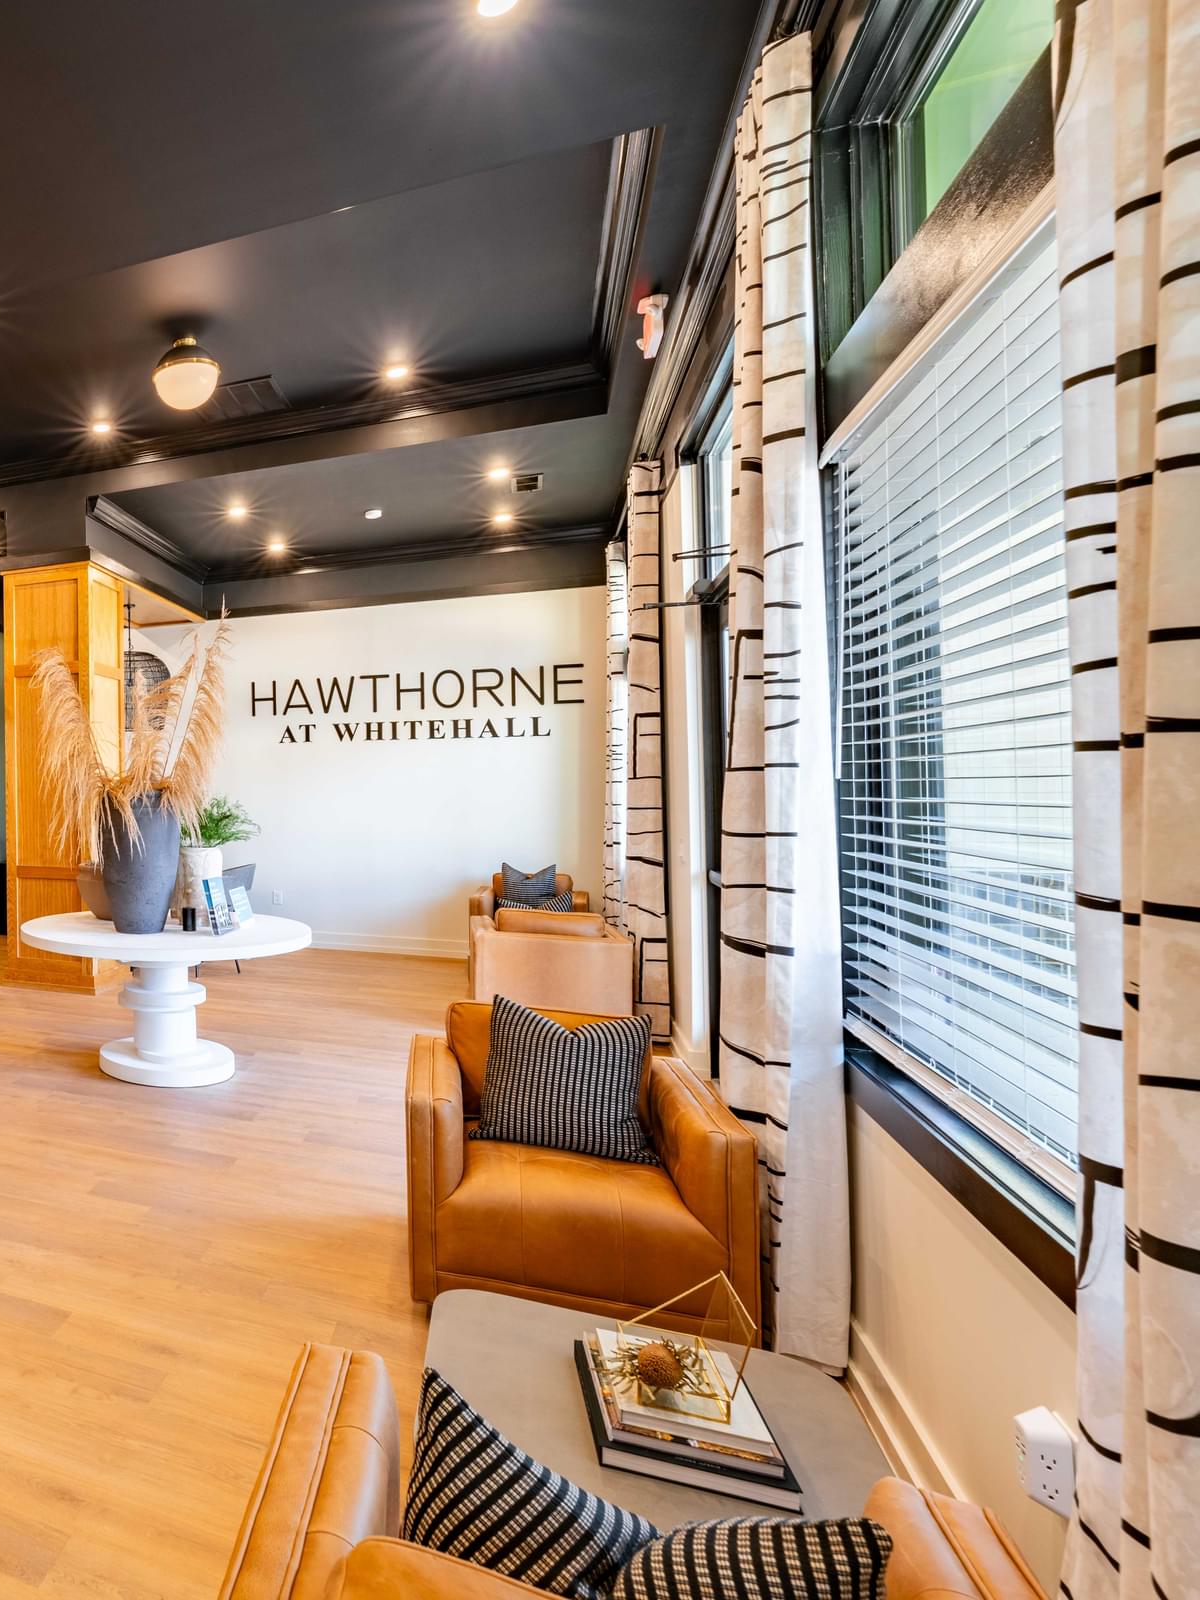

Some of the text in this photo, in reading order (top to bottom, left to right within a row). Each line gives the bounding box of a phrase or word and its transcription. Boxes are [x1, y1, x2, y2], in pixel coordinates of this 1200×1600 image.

[251, 663, 585, 717] HAWTHORNE
[279, 716, 552, 744] AT WHITEHALL
